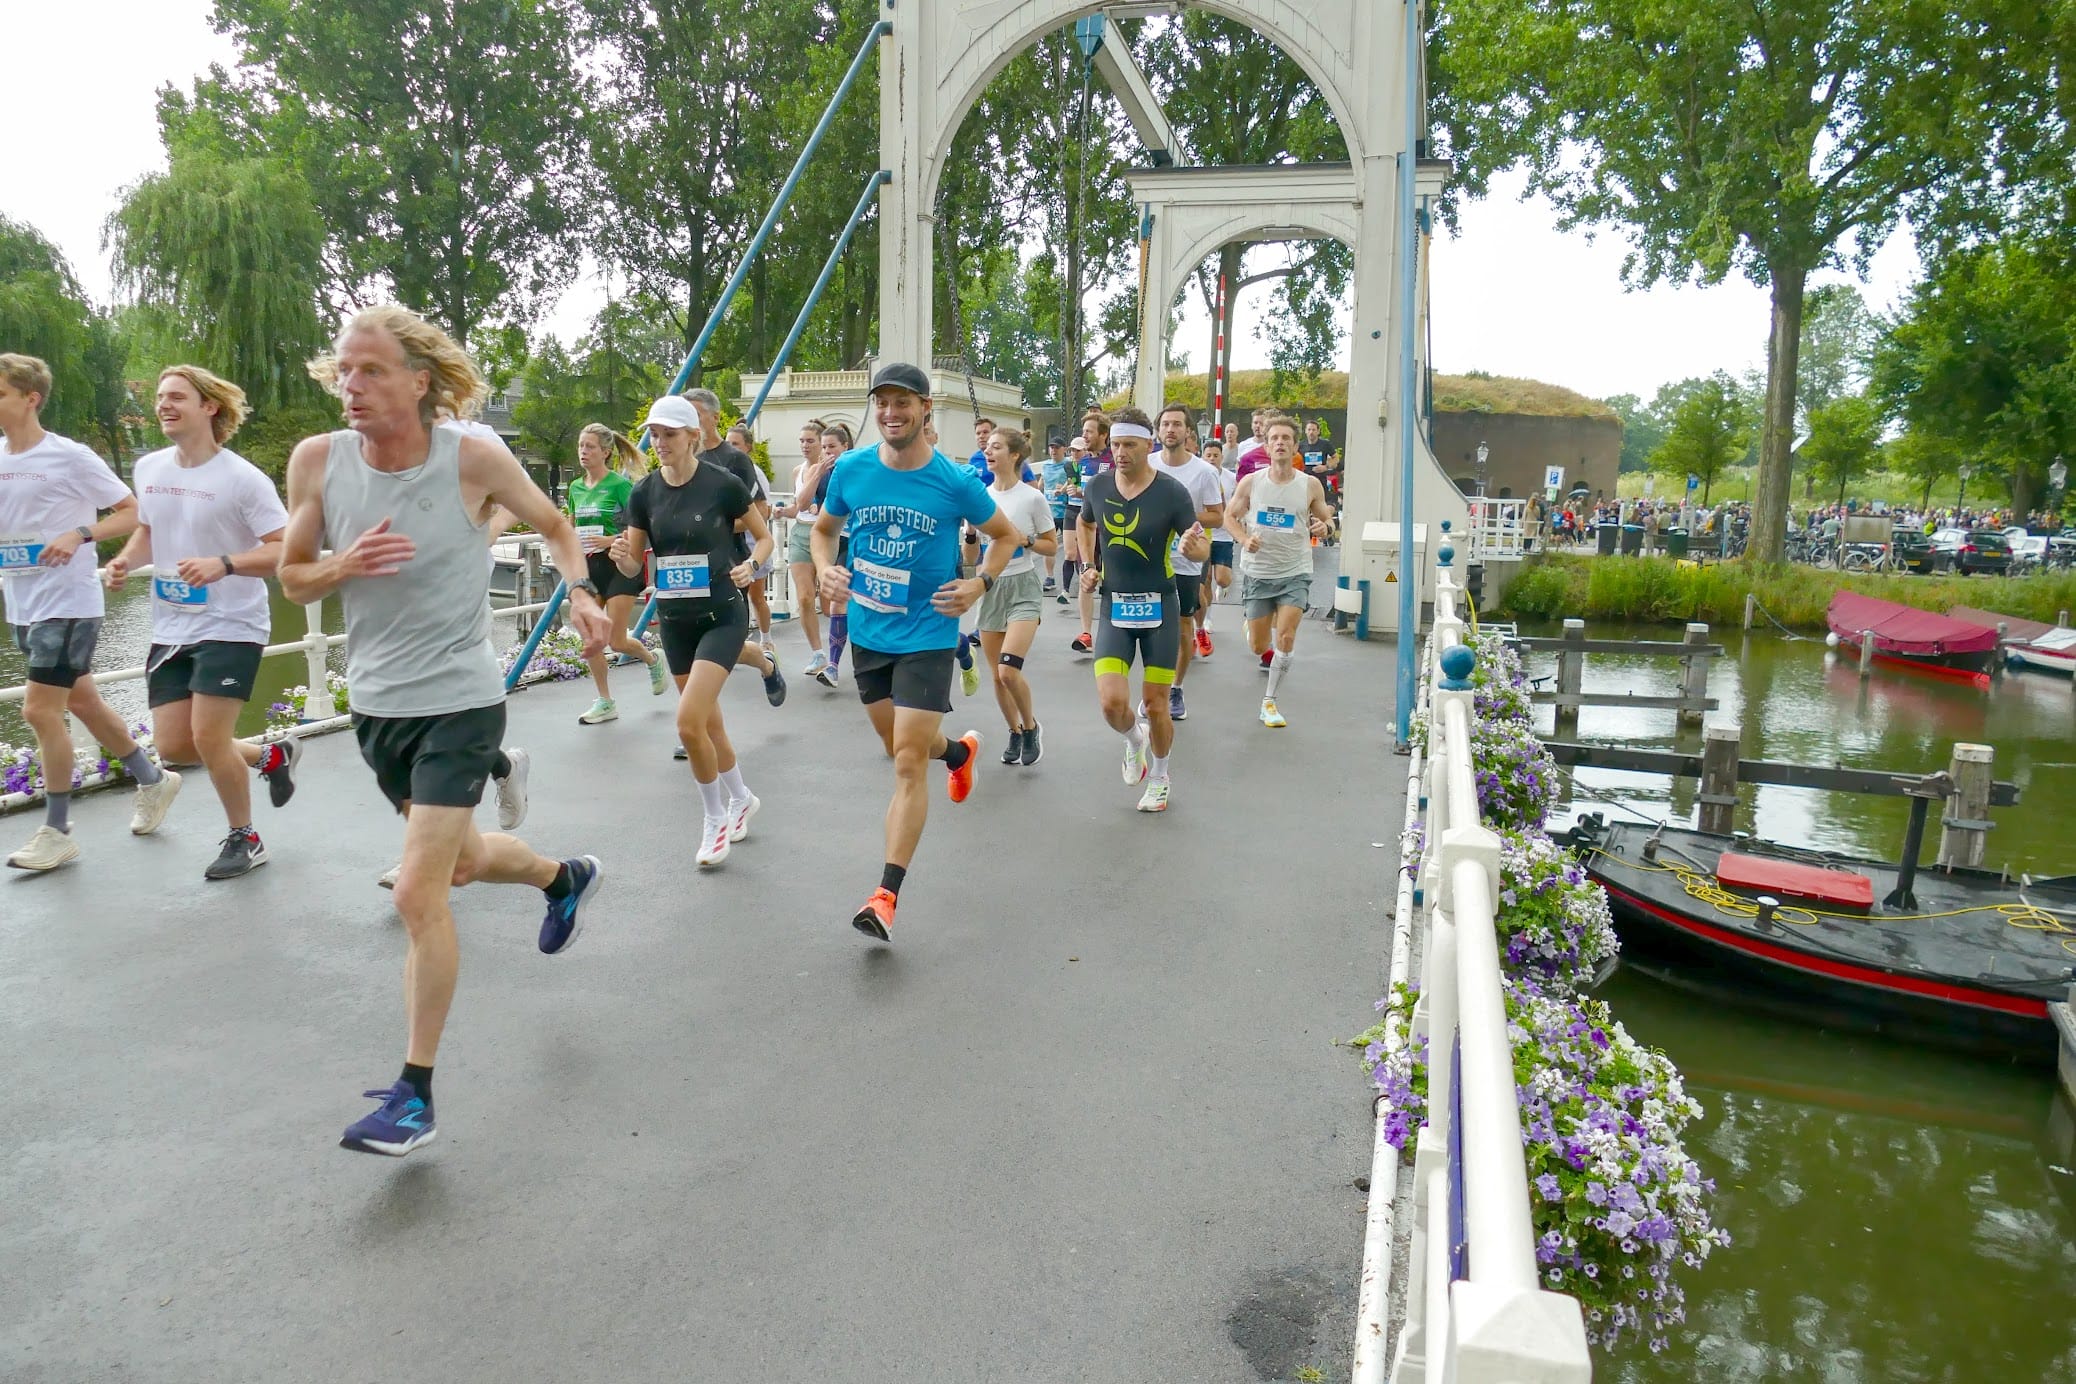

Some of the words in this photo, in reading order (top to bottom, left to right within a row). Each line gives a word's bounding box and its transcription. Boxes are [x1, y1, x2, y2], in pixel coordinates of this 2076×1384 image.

[1266, 513, 1285, 524] 556
[869, 534, 917, 558] LOOPT
[0, 547, 28, 561] 703
[667, 569, 694, 584] 835
[865, 576, 892, 598] 933
[1120, 604, 1153, 616] 1232
